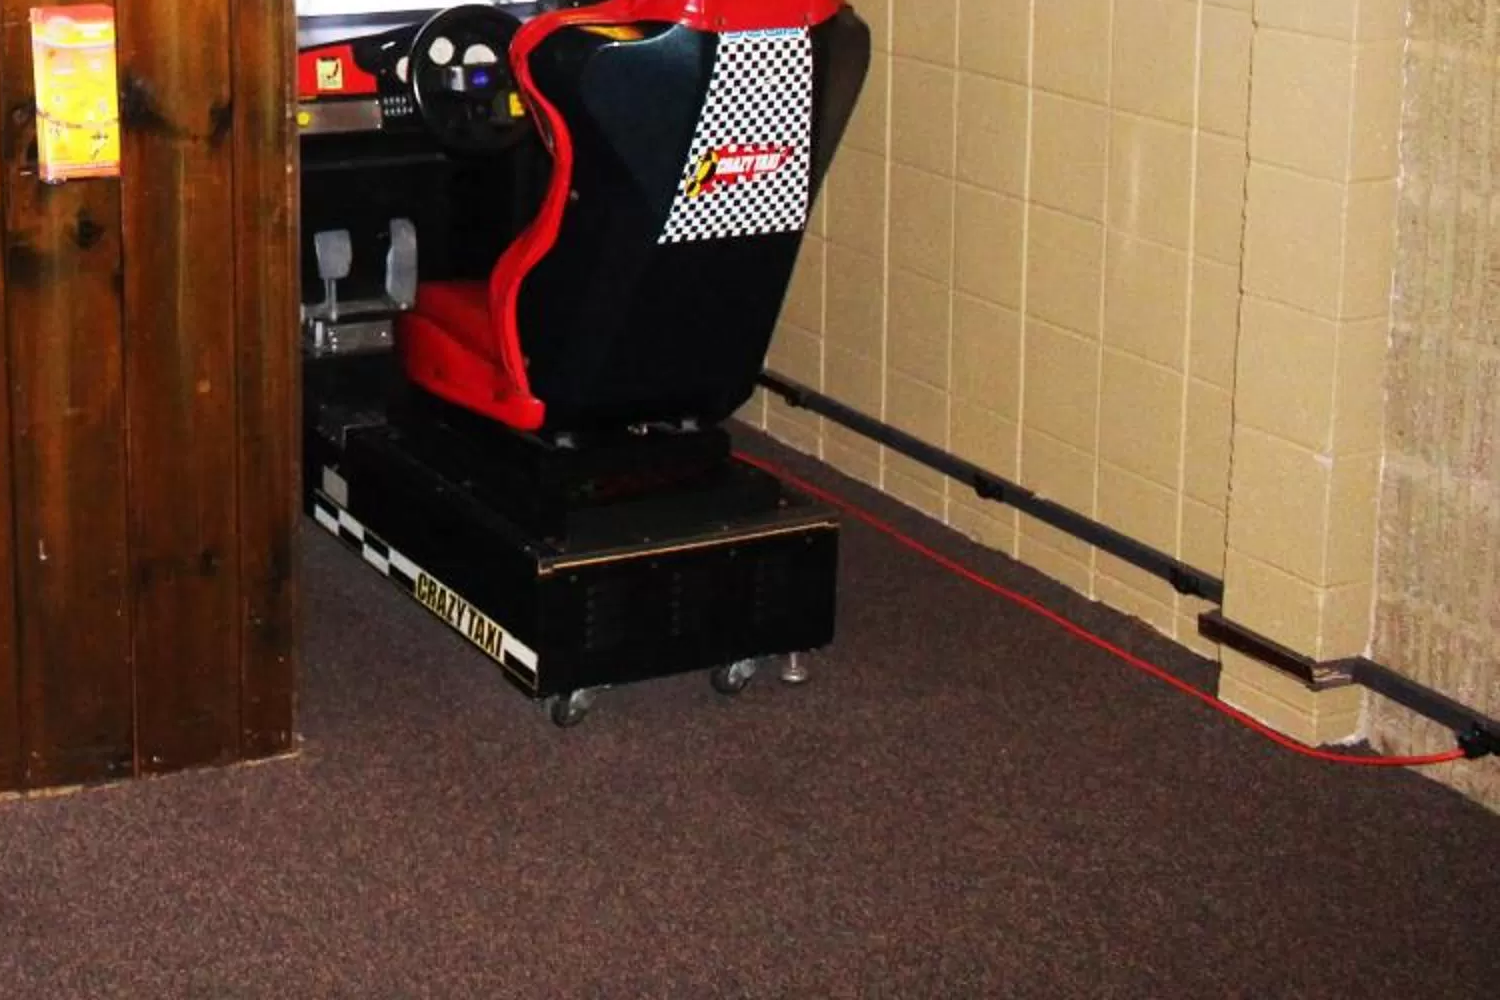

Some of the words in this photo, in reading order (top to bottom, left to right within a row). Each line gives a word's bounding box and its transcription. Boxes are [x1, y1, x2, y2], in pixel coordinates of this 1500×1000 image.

[714, 155, 757, 175] CRAZY
[752, 152, 781, 172] TAXI
[416, 571, 468, 628] CRAZY
[467, 606, 504, 657] TAXI
